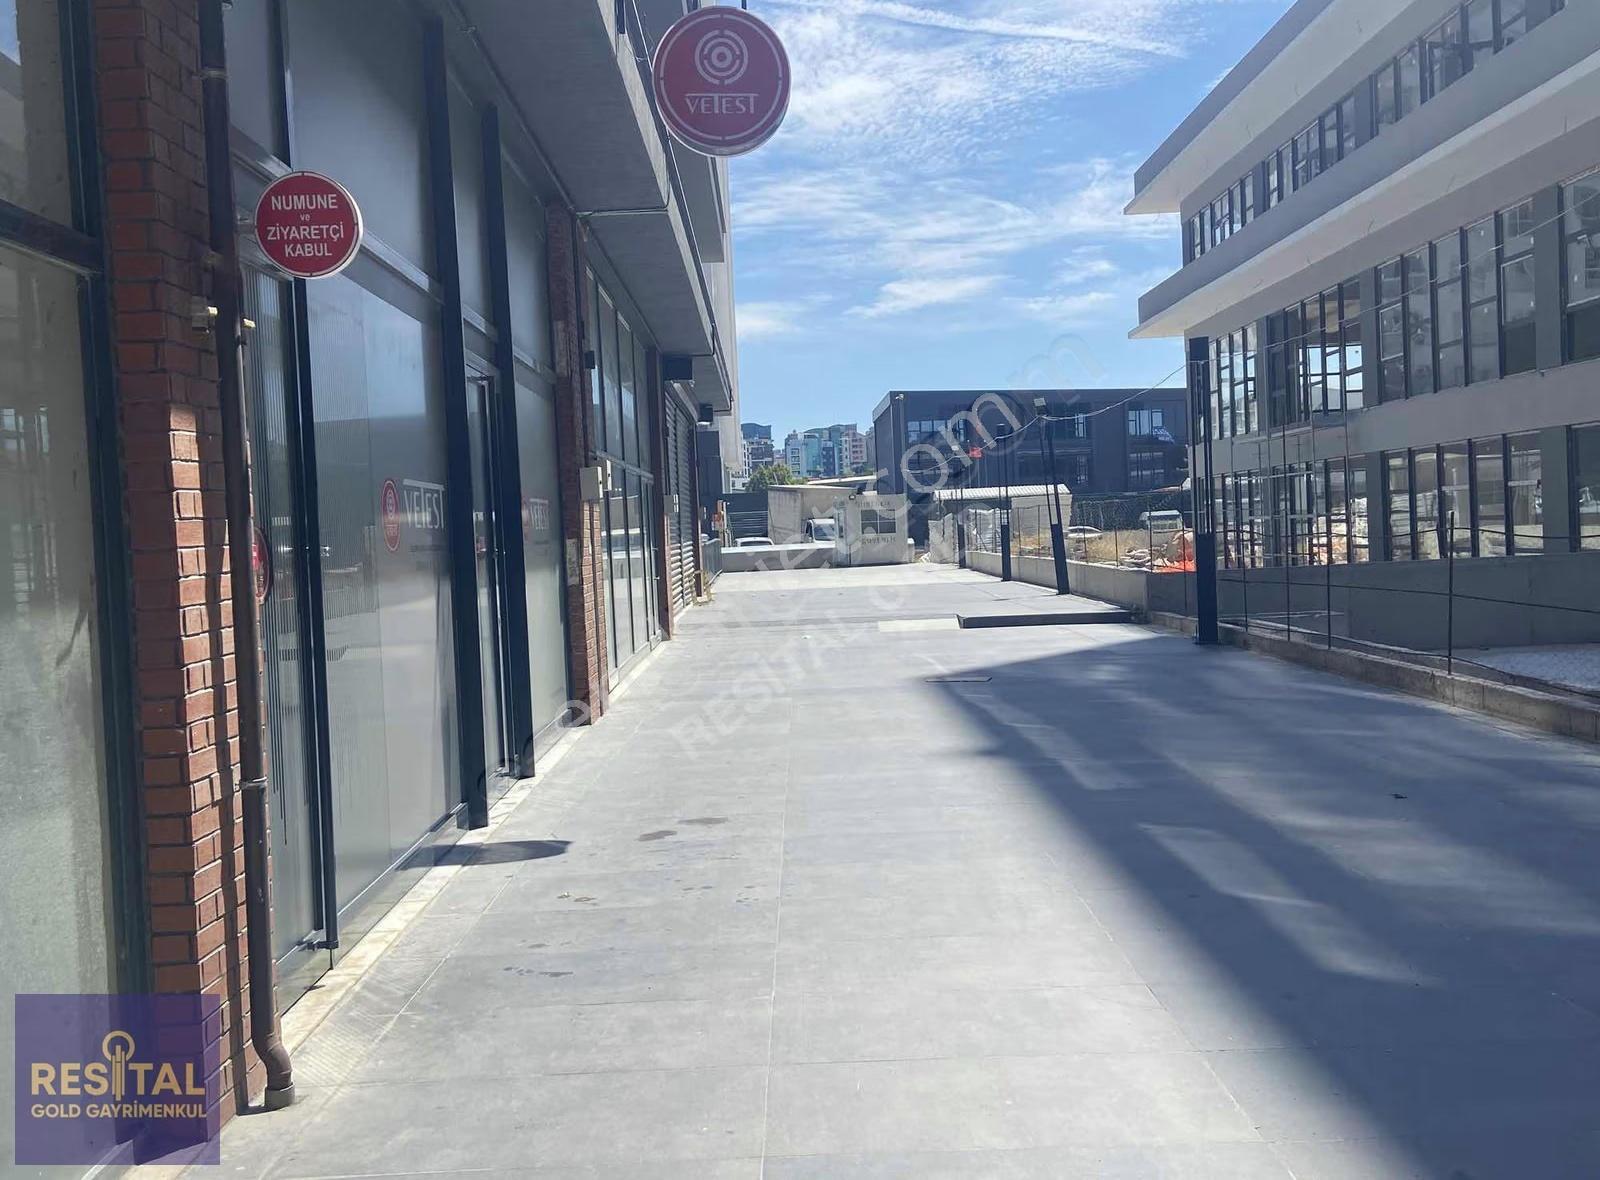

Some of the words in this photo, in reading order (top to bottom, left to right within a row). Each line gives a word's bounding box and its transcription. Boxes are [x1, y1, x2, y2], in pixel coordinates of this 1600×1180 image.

[684, 93, 759, 115] VETEST
[271, 194, 338, 210] NUMUNE
[267, 222, 344, 242] ZİYARETÇİ
[285, 243, 333, 258] KABUL
[403, 479, 445, 529] VETEST
